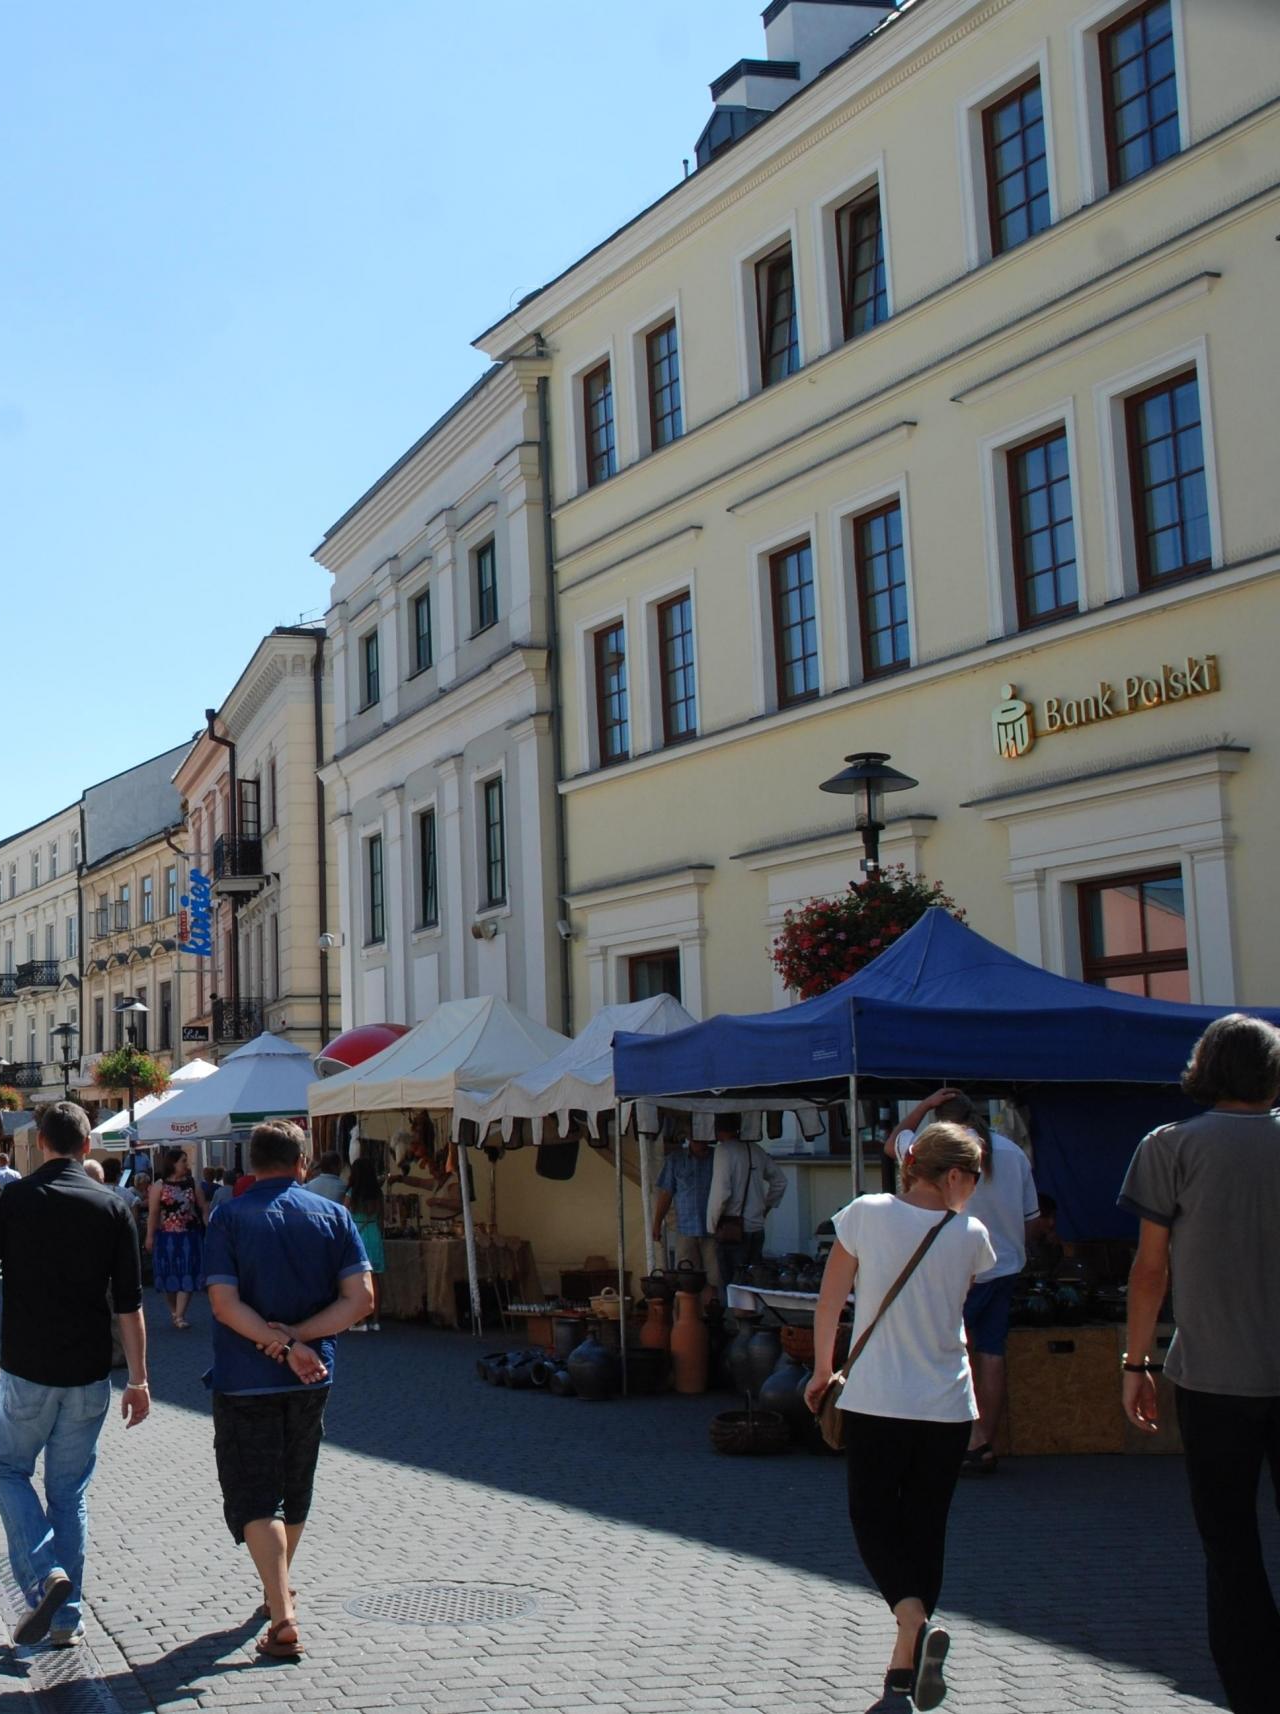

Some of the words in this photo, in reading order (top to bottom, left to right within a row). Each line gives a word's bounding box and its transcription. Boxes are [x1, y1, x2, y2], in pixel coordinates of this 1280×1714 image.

[1043, 682, 1113, 731] Bank
[1123, 655, 1218, 711] Polski
[179, 867, 212, 957] kurier
[170, 1120, 198, 1135] export
